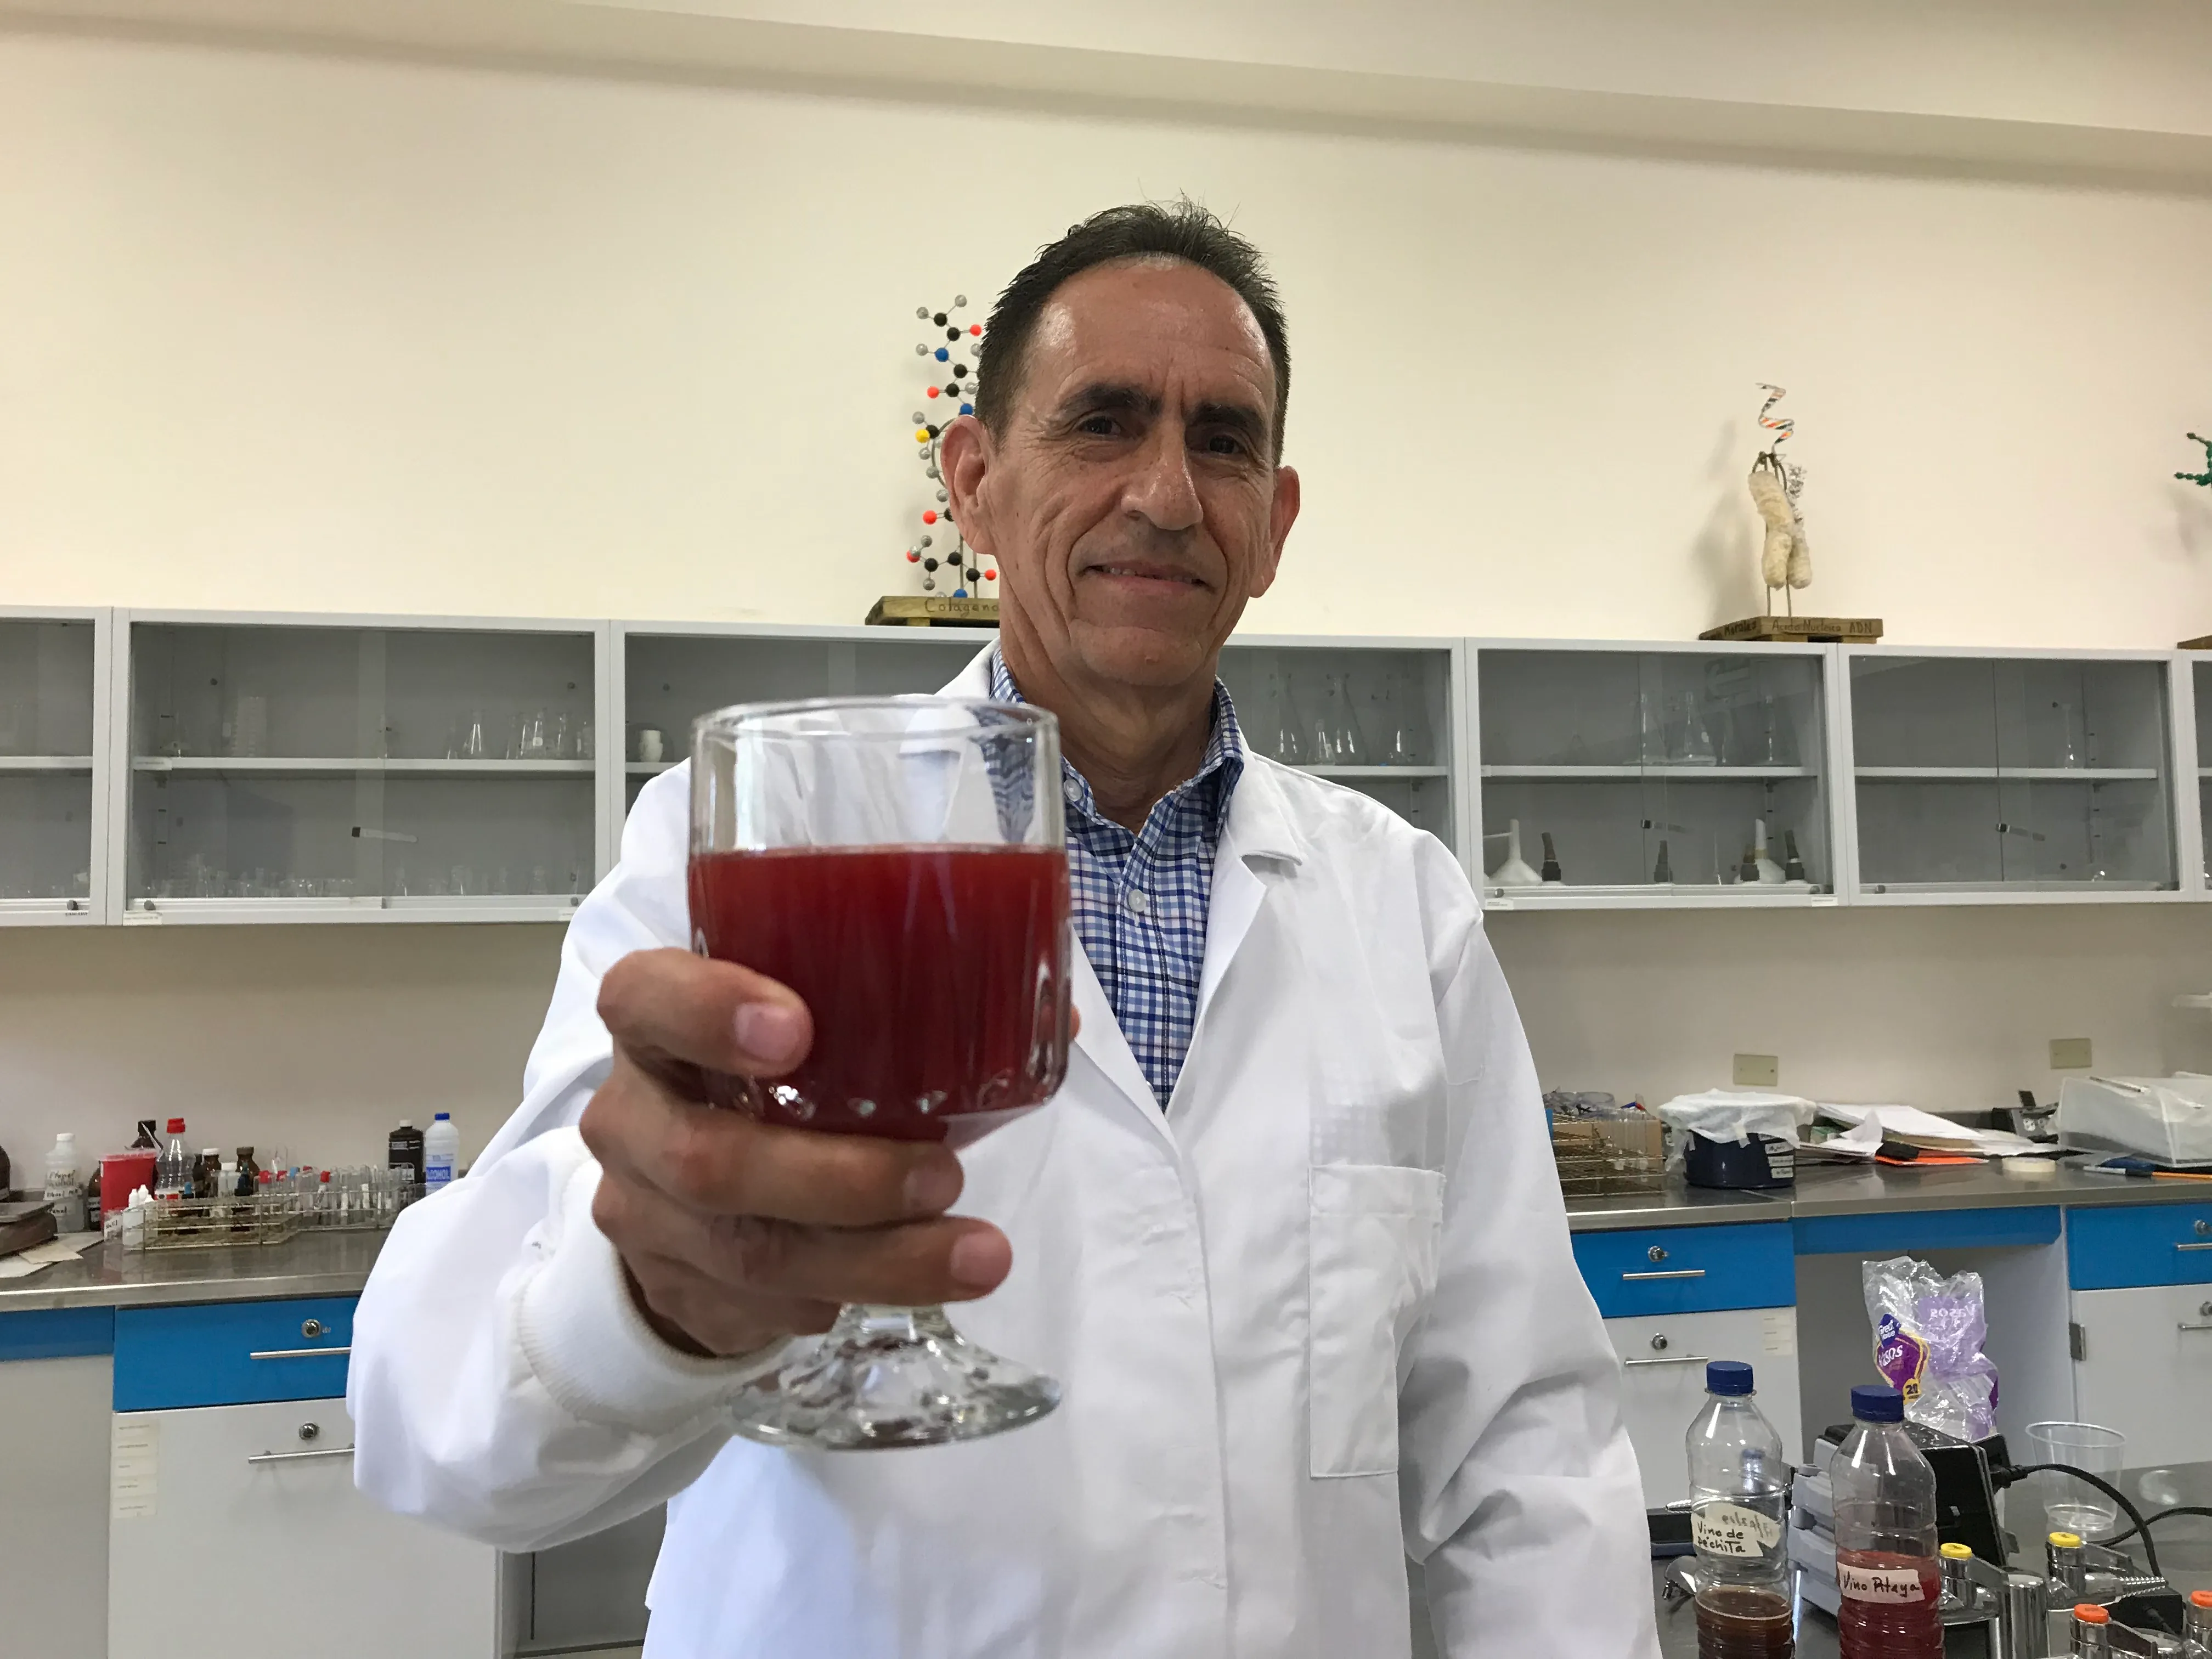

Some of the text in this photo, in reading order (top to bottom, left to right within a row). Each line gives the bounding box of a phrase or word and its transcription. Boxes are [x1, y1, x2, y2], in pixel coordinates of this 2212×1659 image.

[1849, 621, 1872, 634] ADN
[1697, 1521, 1744, 1539] Vino de
[1843, 1571, 1867, 1591] Vino
